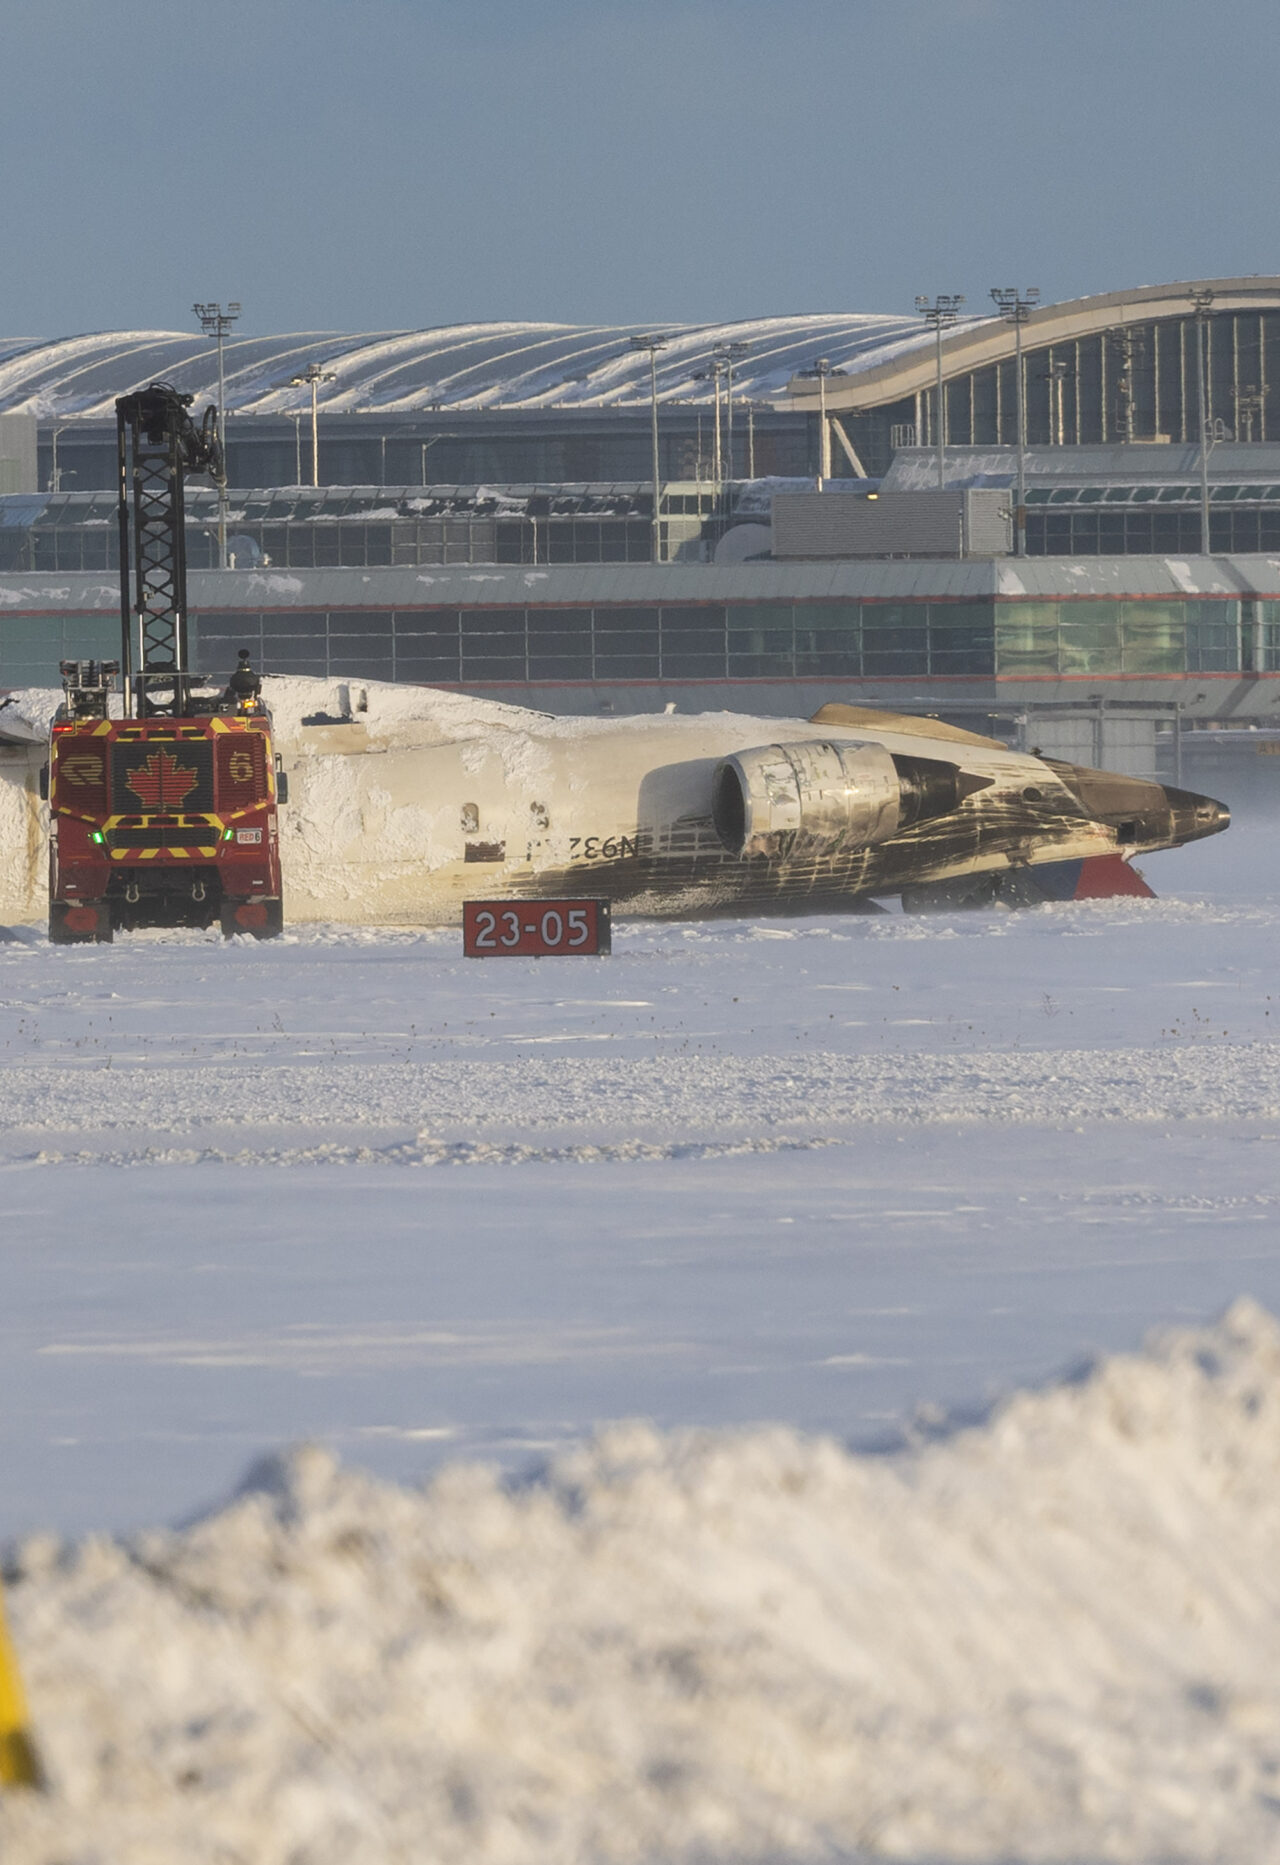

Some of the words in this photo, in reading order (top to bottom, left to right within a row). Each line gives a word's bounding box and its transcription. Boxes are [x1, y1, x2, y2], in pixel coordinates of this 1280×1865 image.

[229, 752, 254, 781] 6
[239, 832, 254, 842] RED
[255, 832, 261, 842] 6
[526, 834, 639, 862] N932
[475, 909, 589, 948] 23-05
